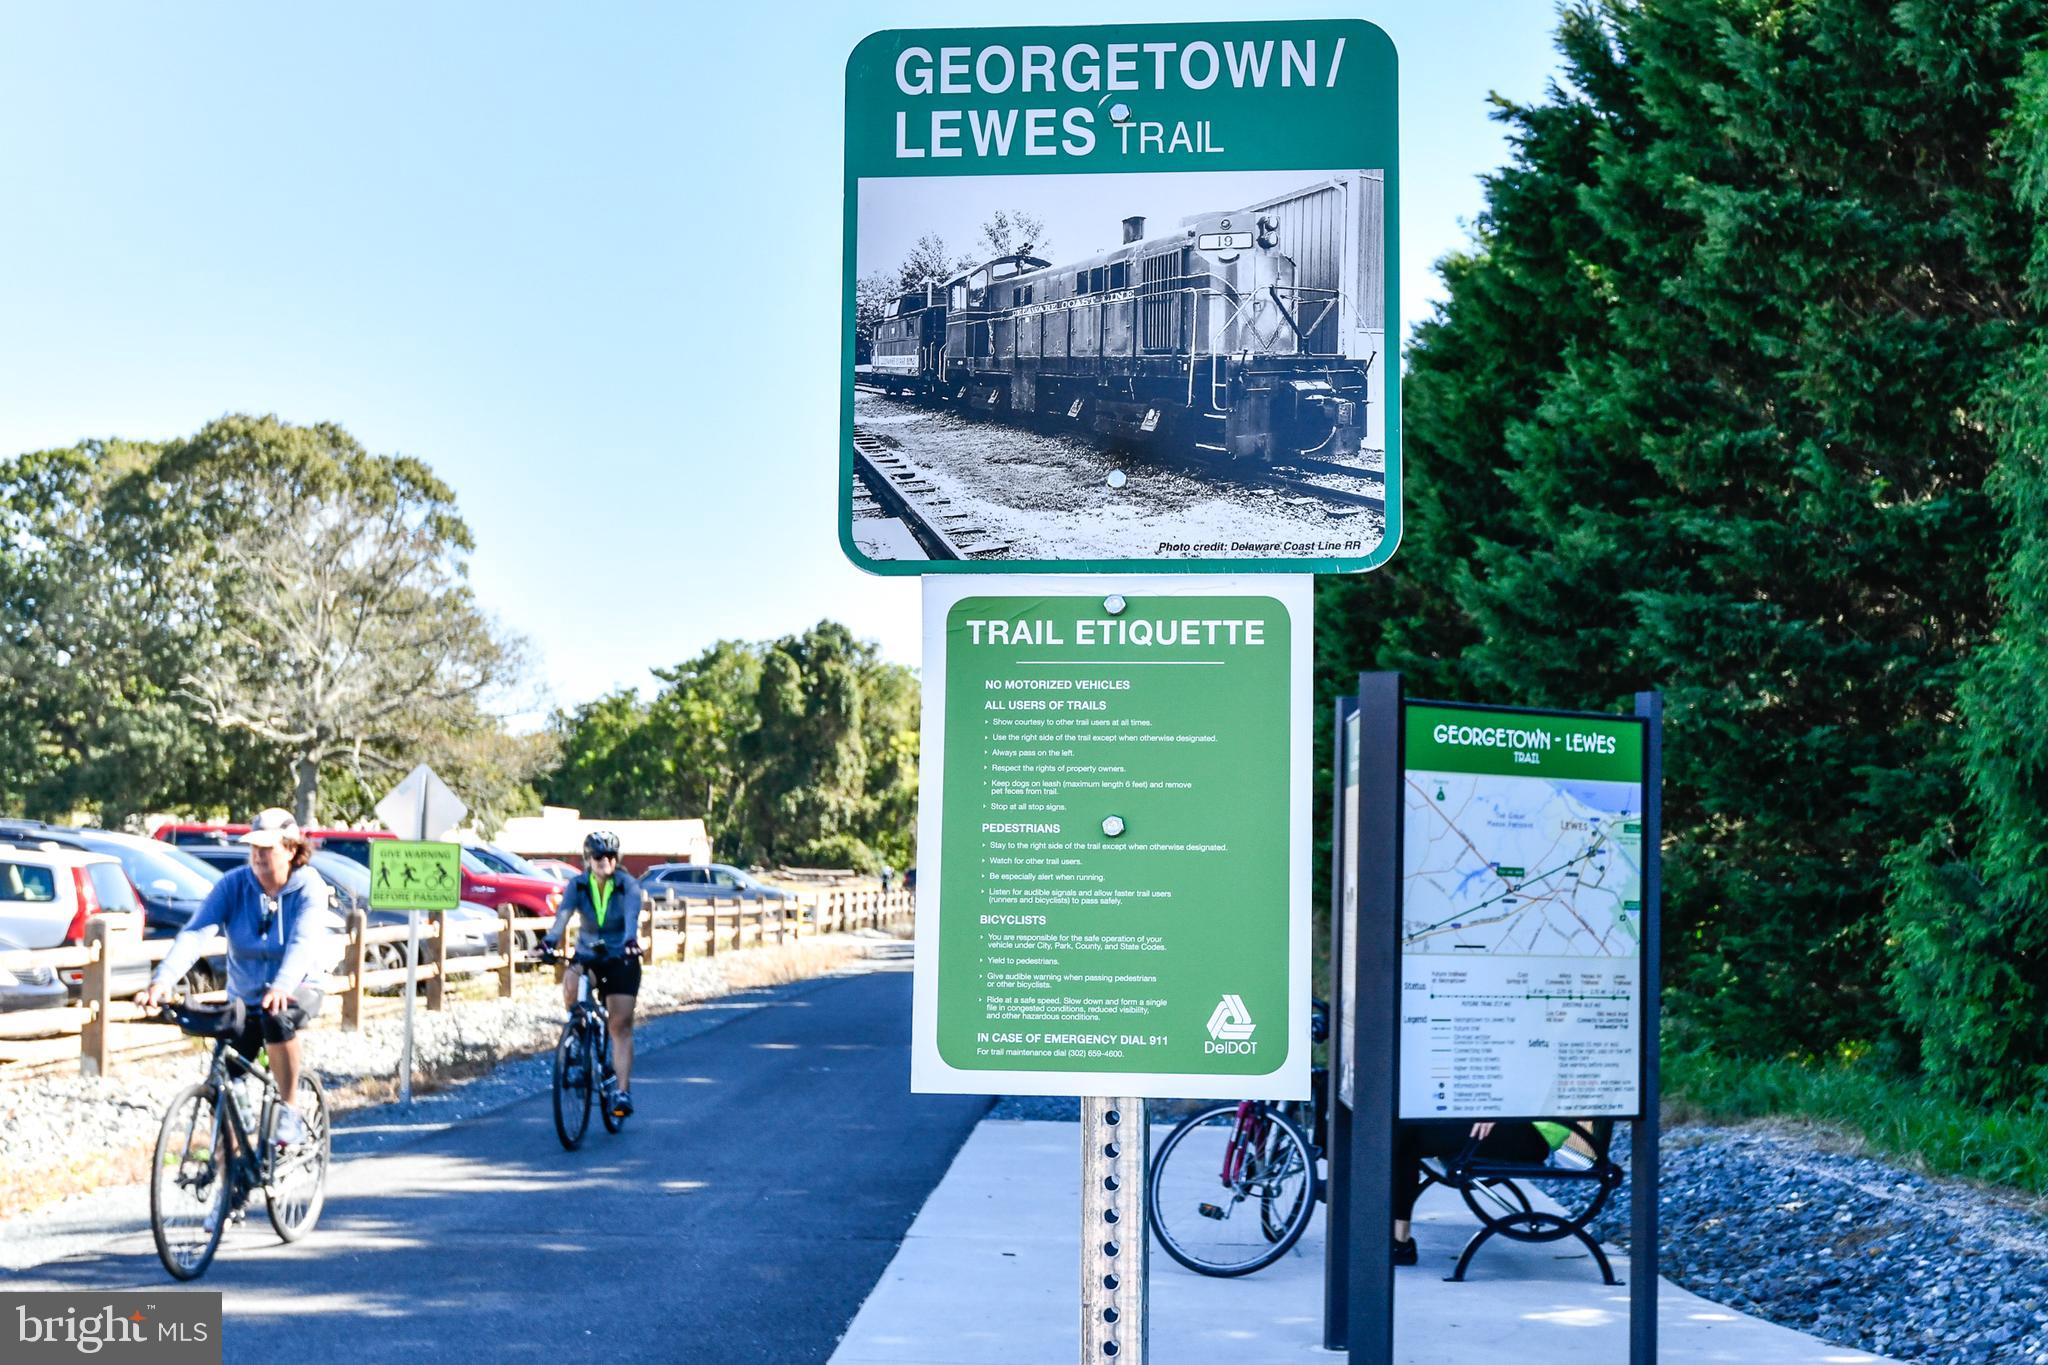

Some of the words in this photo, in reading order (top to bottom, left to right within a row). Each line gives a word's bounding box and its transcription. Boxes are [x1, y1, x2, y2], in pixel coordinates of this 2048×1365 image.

[895, 37, 1346, 95] GEORGETOWN/
[895, 107, 1097, 158] LEWES
[1113, 121, 1225, 154] TRAIL
[1218, 235, 1233, 247] 19
[1012, 303, 1058, 316] DELAWARE
[1061, 296, 1097, 309] COAST
[1102, 290, 1135, 303] LINE
[1158, 542, 1190, 552] Photo
[1193, 542, 1228, 551] credit:
[1230, 541, 1280, 551] Delaware
[1283, 541, 1316, 551] Coast
[1318, 541, 1341, 551] Line
[1345, 541, 1361, 550] RR
[966, 620, 1064, 645] TRAIL
[1076, 620, 1264, 648] ETIQUETTE
[985, 680, 1002, 690] NO
[1005, 680, 1072, 690] MOTORIZED
[1075, 680, 1130, 690] VEHICLES
[984, 701, 1006, 710] ALL
[1008, 701, 1046, 710] USERS
[1049, 701, 1064, 710] OF
[1066, 701, 1107, 710] TRAILS
[1014, 718, 1045, 727] courtesy
[1021, 734, 1037, 742] right
[1092, 734, 1117, 743] except
[1176, 734, 1217, 743] designated.
[1433, 724, 1551, 750] GEORGETOWN
[1566, 732, 1617, 754] LEWES
[992, 749, 1017, 758] Always
[1513, 751, 1541, 764] TRAIL
[992, 764, 1021, 773] Respect
[1035, 765, 1056, 773] rights
[1066, 765, 1097, 773] property
[991, 780, 1010, 788] Keep
[1011, 780, 1030, 788] dogs
[1101, 781, 1124, 789] length
[1132, 781, 1148, 789] feet)
[991, 803, 1008, 812] Stop
[1028, 804, 1045, 812] stop
[1046, 804, 1066, 812] signs.
[982, 824, 1061, 833] PEDESTRIANS
[1560, 821, 1588, 831] LEWES
[990, 842, 1006, 850] Stay
[1030, 842, 1046, 850] right
[1102, 843, 1127, 852] except
[1185, 844, 1228, 853] designated.
[380, 850, 400, 858] GIVE
[404, 850, 451, 859] WARNING
[1001, 873, 1036, 881] especially
[1076, 874, 1105, 882] running.
[373, 891, 409, 901] BEFORE
[414, 891, 456, 902] PASSING
[1051, 889, 1077, 898] signals
[980, 915, 1046, 925] BICYCLISTS
[1016, 957, 1059, 966] pedestrians.
[1033, 974, 1062, 982] warning
[1084, 974, 1113, 983] passing
[1114, 974, 1157, 984] pedestrians
[1037, 997, 1061, 1006] speed.
[1146, 999, 1167, 1007] single
[977, 1033, 989, 1042] IN
[992, 1033, 1023, 1043] CASE
[1025, 1033, 1041, 1043] OF
[1044, 1034, 1117, 1044] EMERGENCY
[1120, 1035, 1146, 1045] DIAL
[1149, 1035, 1167, 1045] 911
[1204, 1040, 1257, 1054] DelDOT
[1068, 1050, 1086, 1058] (302)
